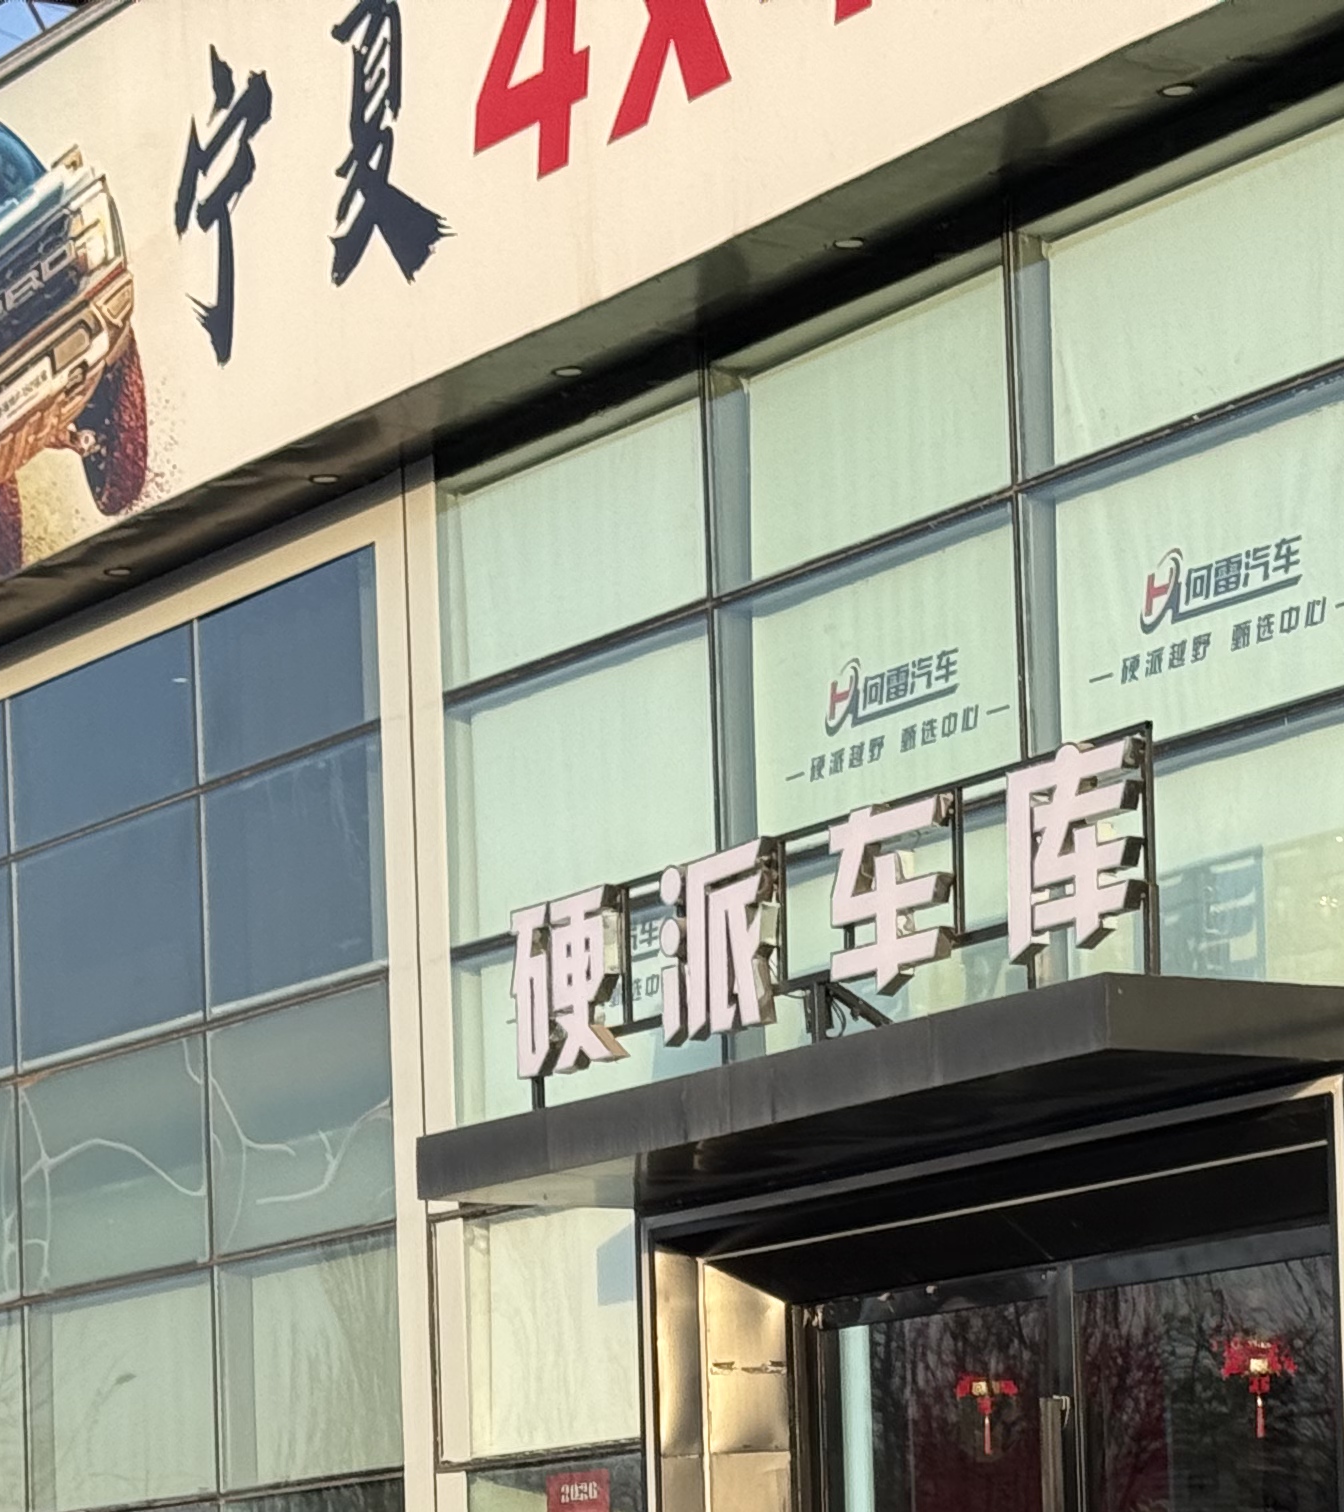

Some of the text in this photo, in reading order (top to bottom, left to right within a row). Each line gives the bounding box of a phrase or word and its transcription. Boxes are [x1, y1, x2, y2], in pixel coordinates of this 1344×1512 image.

[1184, 535, 1302, 606] 何雷汽车
[863, 647, 958, 711] 何雷汽车
[1121, 596, 1327, 684] 硬派越野 甄选中心
[510, 738, 1143, 1080] 硬派车库
